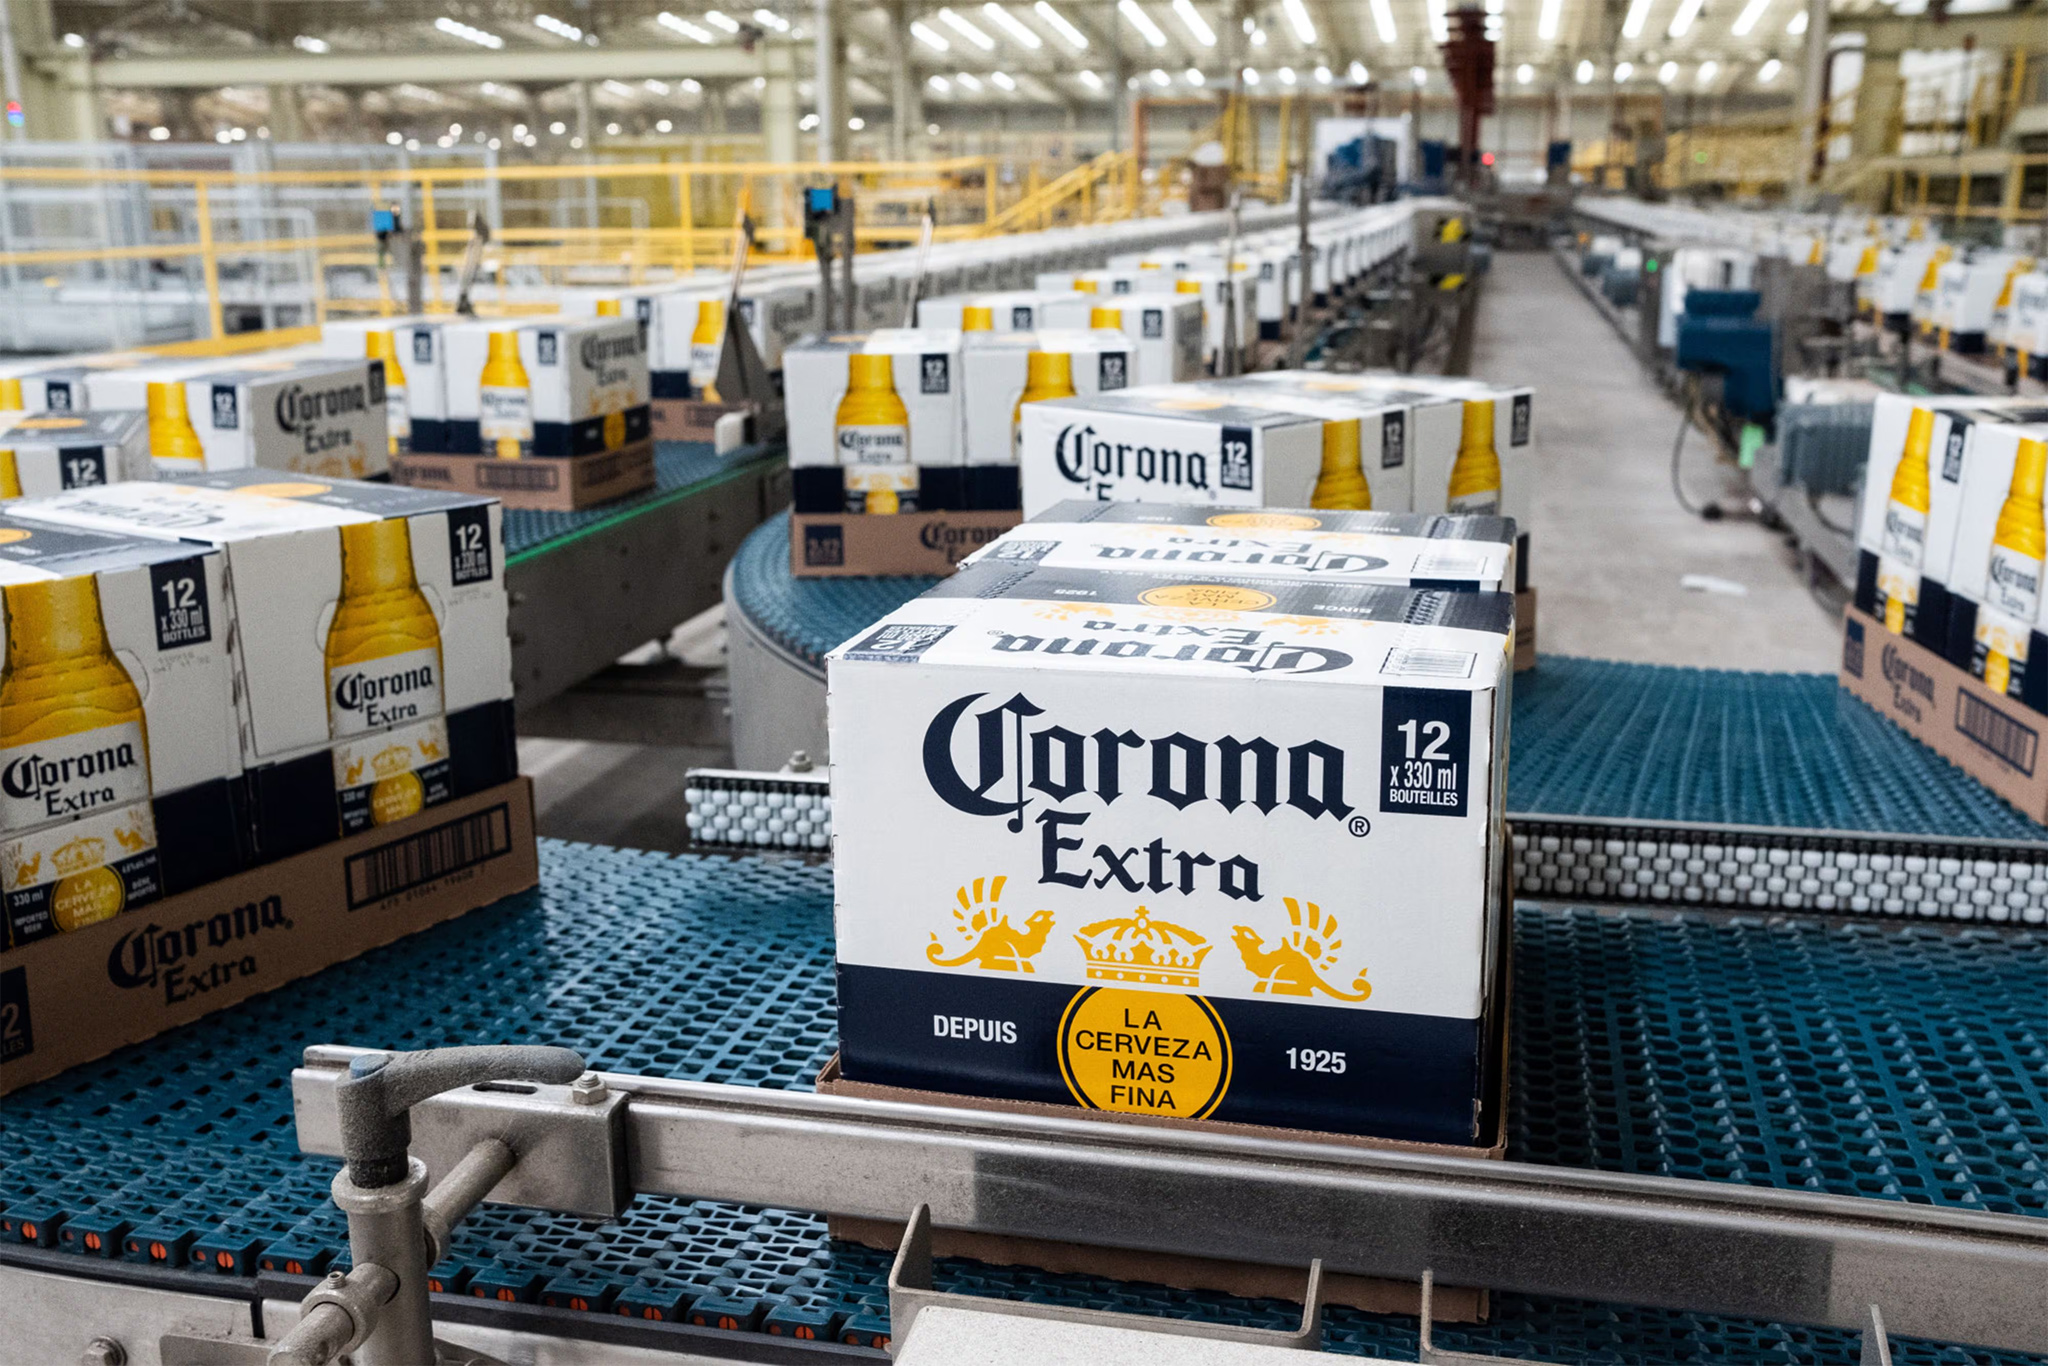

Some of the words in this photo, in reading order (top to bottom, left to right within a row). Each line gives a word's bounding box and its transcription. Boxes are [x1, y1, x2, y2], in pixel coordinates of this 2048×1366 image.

[1055, 424, 1209, 492] Corona
[1224, 441, 1249, 464] 12
[67, 458, 98, 482] 12
[456, 523, 483, 552] 12
[1097, 546, 1390, 573] Corona
[161, 577, 197, 610] 12
[161, 614, 168, 632] x
[169, 608, 188, 629] 330
[190, 605, 204, 628] ml
[1312, 604, 1373, 615] SINCE
[162, 625, 207, 644] BOTTLES
[1082, 619, 1266, 646] Extra
[870, 639, 919, 655] 12
[991, 633, 1354, 674] Corona
[335, 665, 435, 713] Corona
[366, 703, 418, 727] Extra
[1398, 719, 1451, 761] 12
[2, 743, 137, 801] Corona
[922, 692, 1356, 834] Corona
[1390, 765, 1400, 787] x
[1404, 760, 1433, 789] 330
[1437, 762, 1457, 790] ml
[45, 787, 115, 818] Extra
[1389, 788, 1459, 807] BOUTEILLES
[1035, 808, 1265, 902] Extra
[14, 892, 31, 908] 330
[32, 889, 44, 903] ml
[108, 894, 288, 989] Corona
[162, 955, 258, 1006] Extra
[933, 1014, 1018, 1044] DEPUIS
[1124, 1007, 1163, 1031] LA
[1075, 1030, 1212, 1062] CERVEZA
[1111, 1059, 1176, 1085] MAS
[1286, 1047, 1347, 1075] 1925
[1110, 1085, 1177, 1111] FINA
